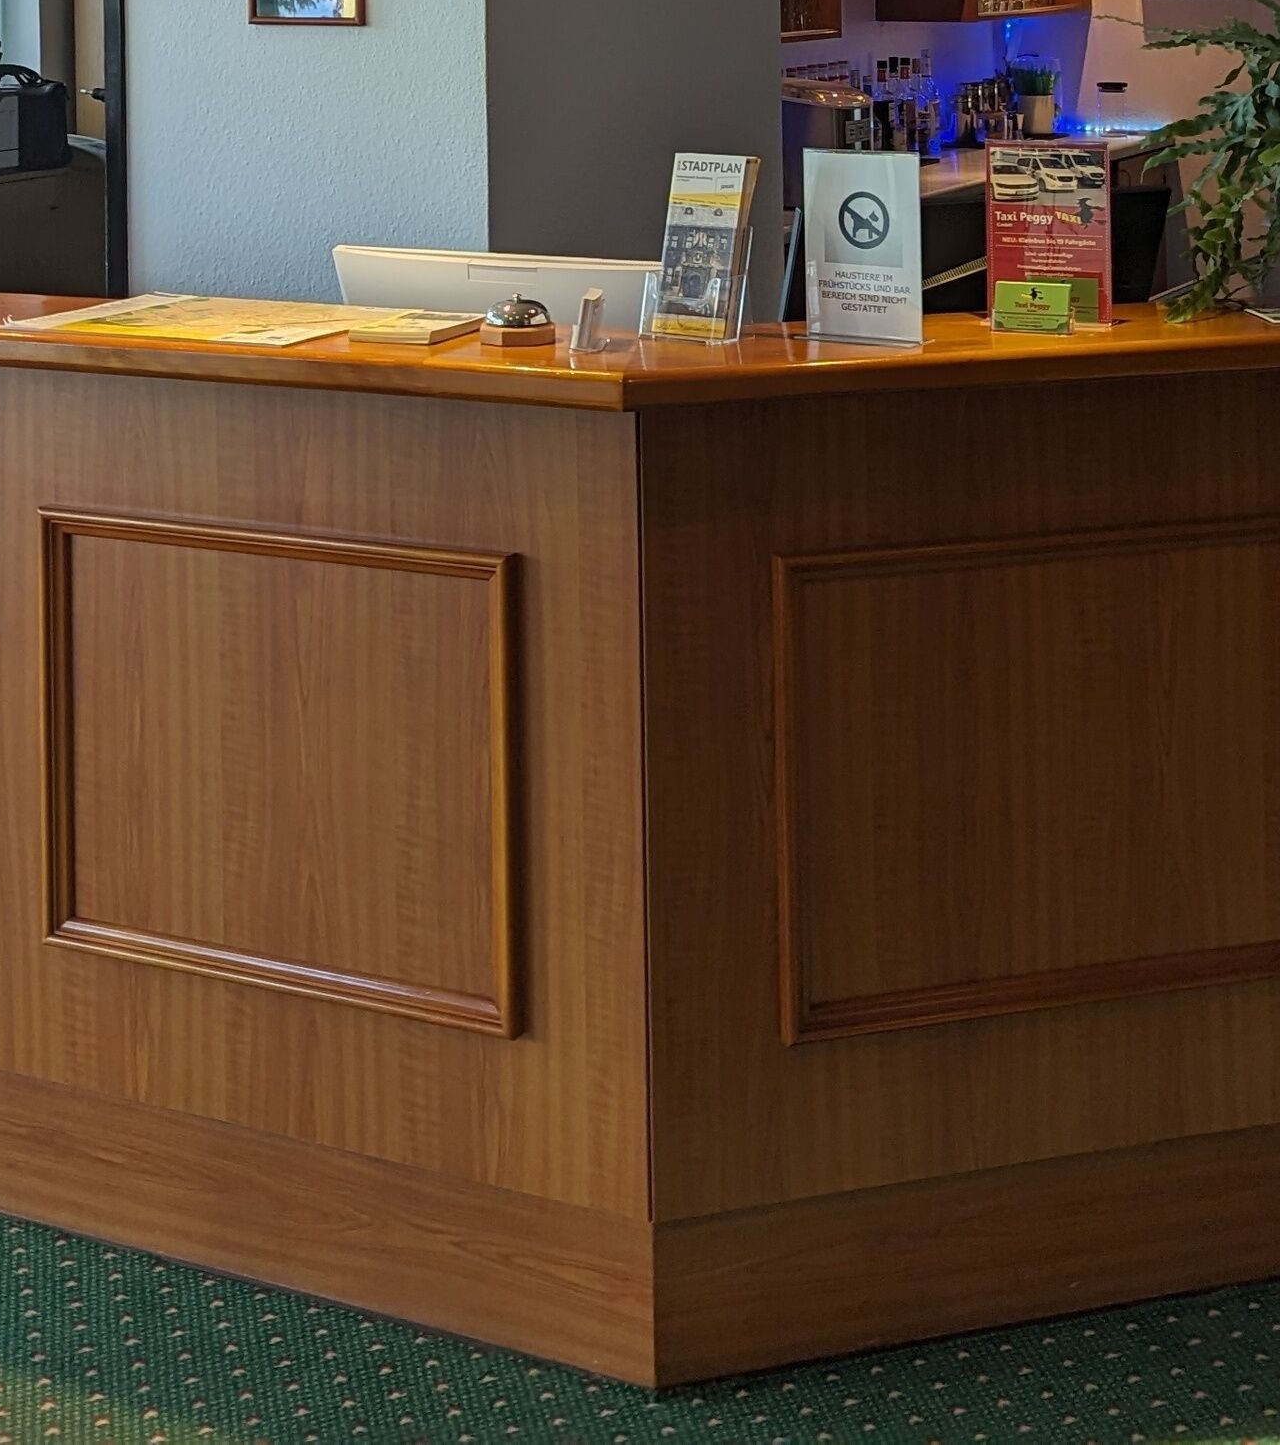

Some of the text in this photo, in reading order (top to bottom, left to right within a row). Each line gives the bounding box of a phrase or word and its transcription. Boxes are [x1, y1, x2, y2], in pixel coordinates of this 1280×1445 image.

[681, 160, 742, 174] STADTPLAN
[994, 210, 1054, 225] Taxi Peggy
[1054, 211, 1083, 225] TAXI
[834, 270, 894, 283] HAUSTIERE IM
[818, 279, 912, 295] FRÜHSTÜCKS UND BAR
[821, 290, 908, 305] BEREICH SIND NICHT
[840, 302, 888, 314] GESTATTET
[1014, 301, 1028, 309] Taxi
[1029, 302, 1051, 311] Peggy
